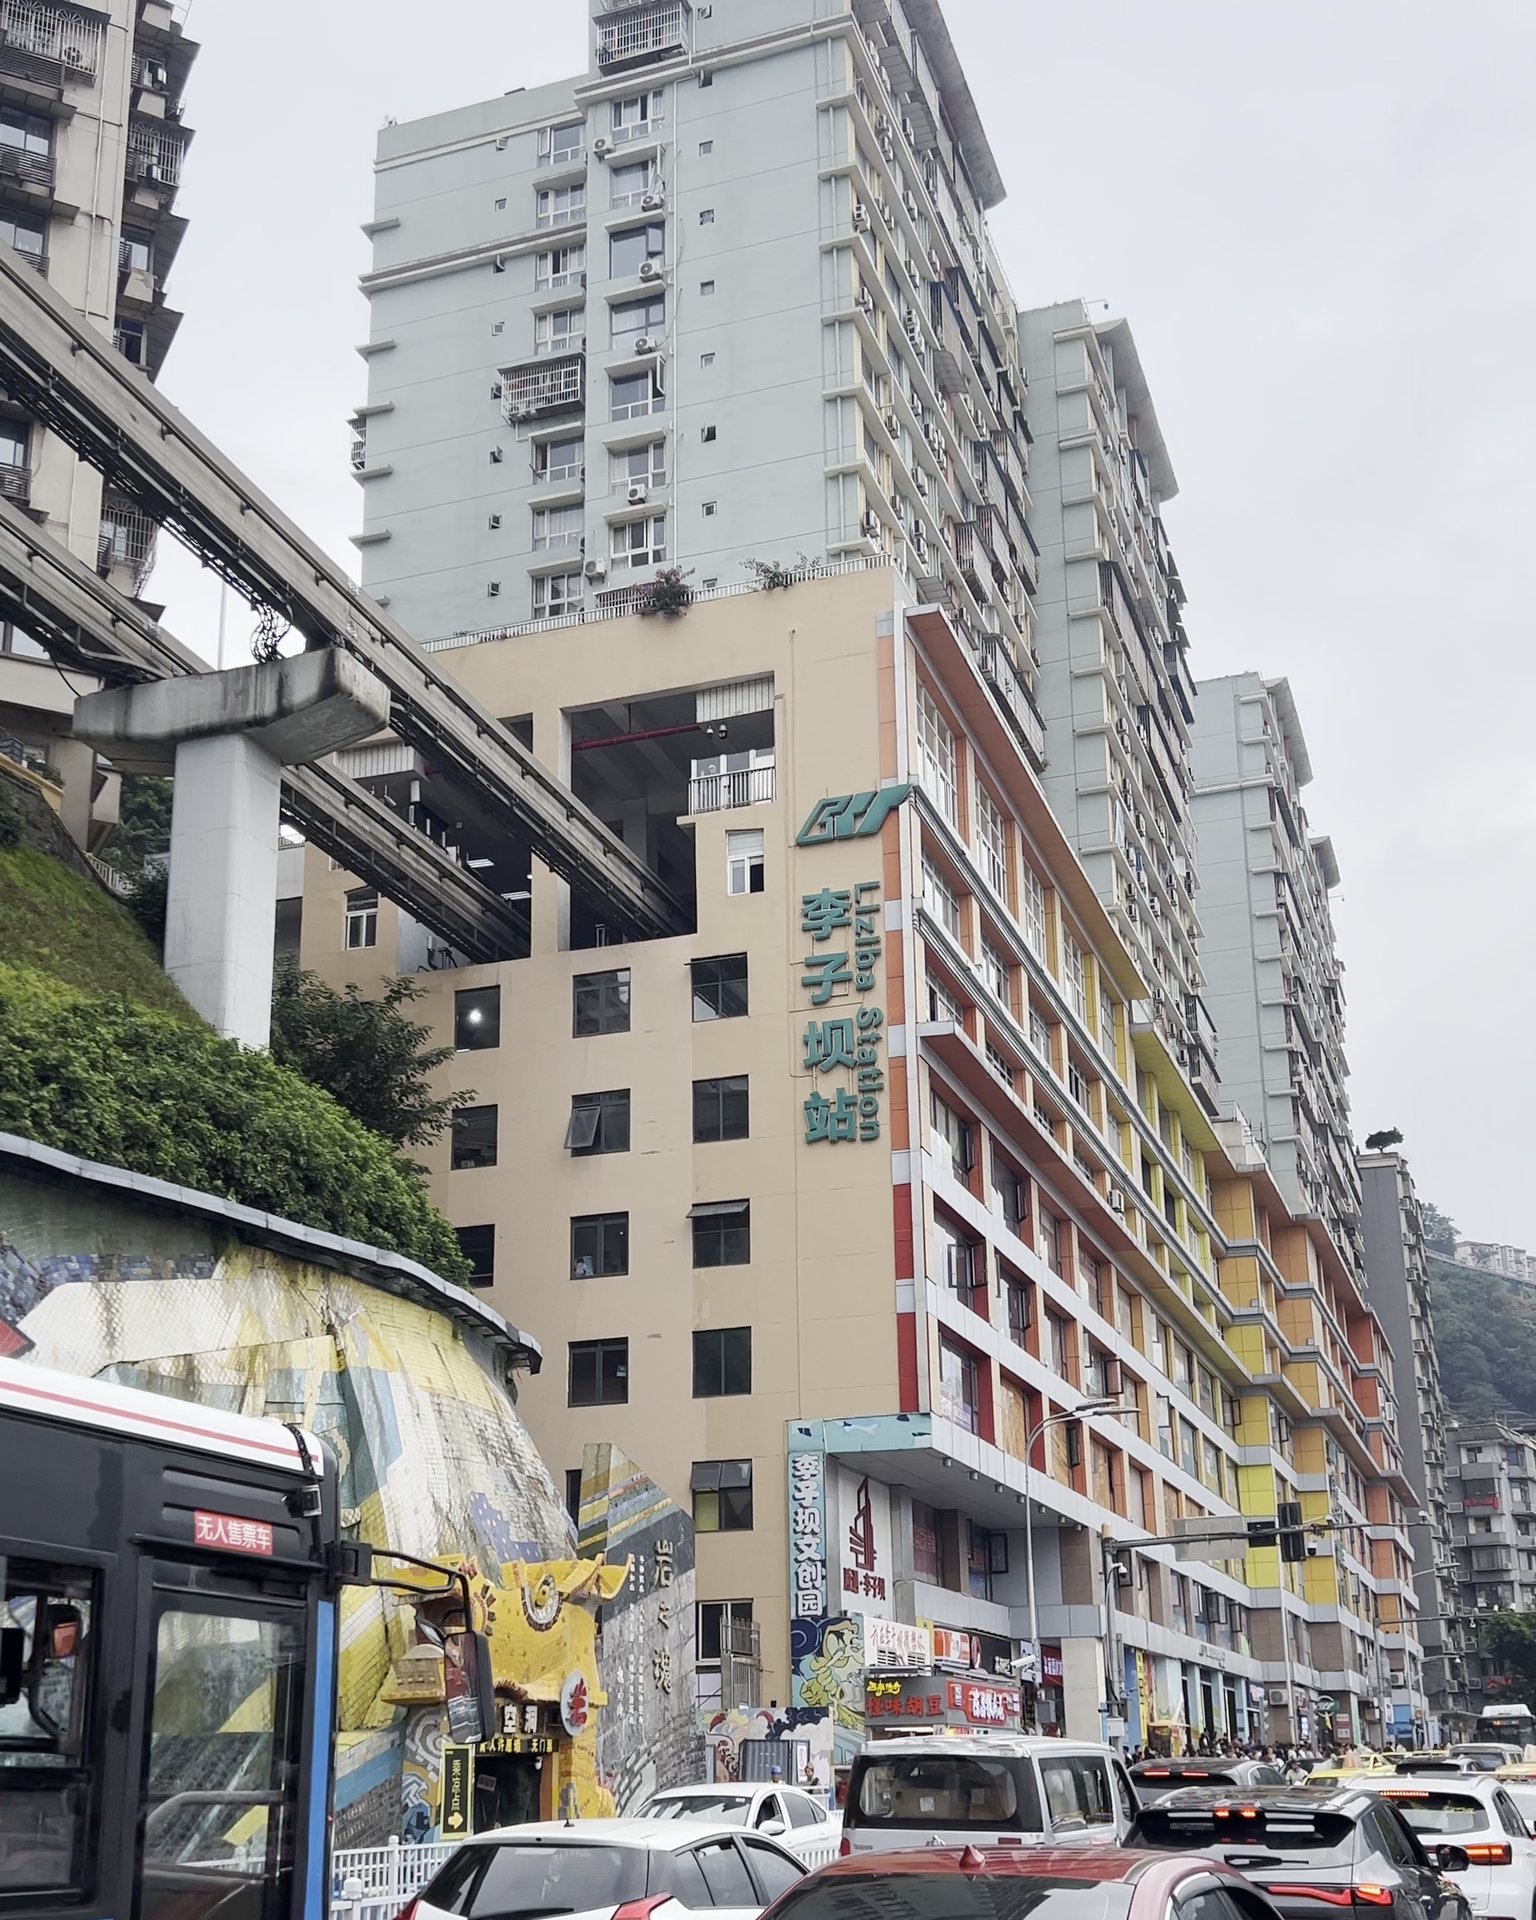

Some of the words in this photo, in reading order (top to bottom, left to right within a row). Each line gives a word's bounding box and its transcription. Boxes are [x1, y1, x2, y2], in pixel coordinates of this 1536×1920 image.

[855, 880, 881, 991] Liziba
[801, 887, 858, 1144] 李子坝站
[856, 1006, 884, 1142] Station
[198, 1516, 271, 1550] 无人售票车
[793, 1453, 824, 1617] 李子坝文创园
[867, 1695, 944, 1717] 怪味胡豆
